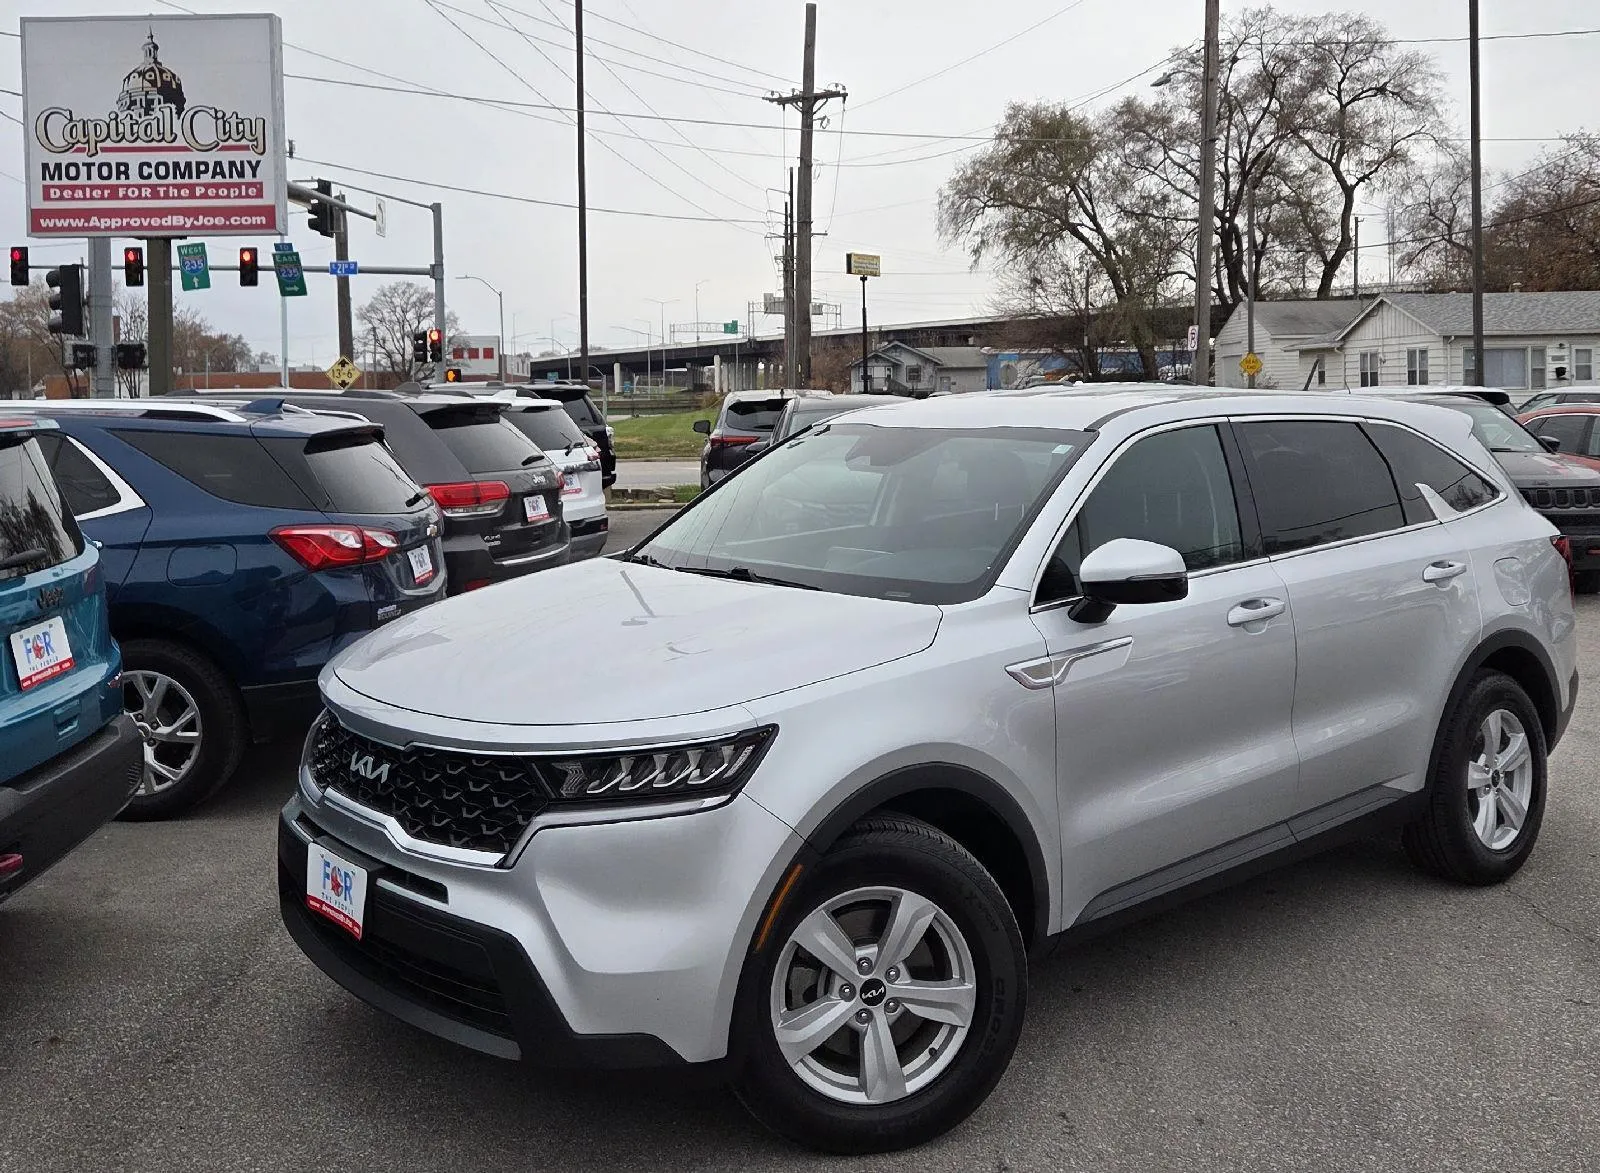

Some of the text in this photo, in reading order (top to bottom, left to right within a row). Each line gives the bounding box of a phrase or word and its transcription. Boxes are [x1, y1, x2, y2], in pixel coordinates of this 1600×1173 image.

[35, 104, 266, 157] Capital City
[41, 160, 262, 181] MOTOR COMPANY
[50, 185, 258, 199] Dealer FOR The People
[39, 214, 267, 229] www.ApprovedByJoe.com
[180, 246, 203, 256] WEST
[184, 260, 204, 271] 235
[279, 266, 300, 278] 235
[532, 474, 546, 484] Jeep
[23, 630, 56, 665] FOR
[350, 750, 391, 784] KIA
[322, 859, 354, 905] FOR
